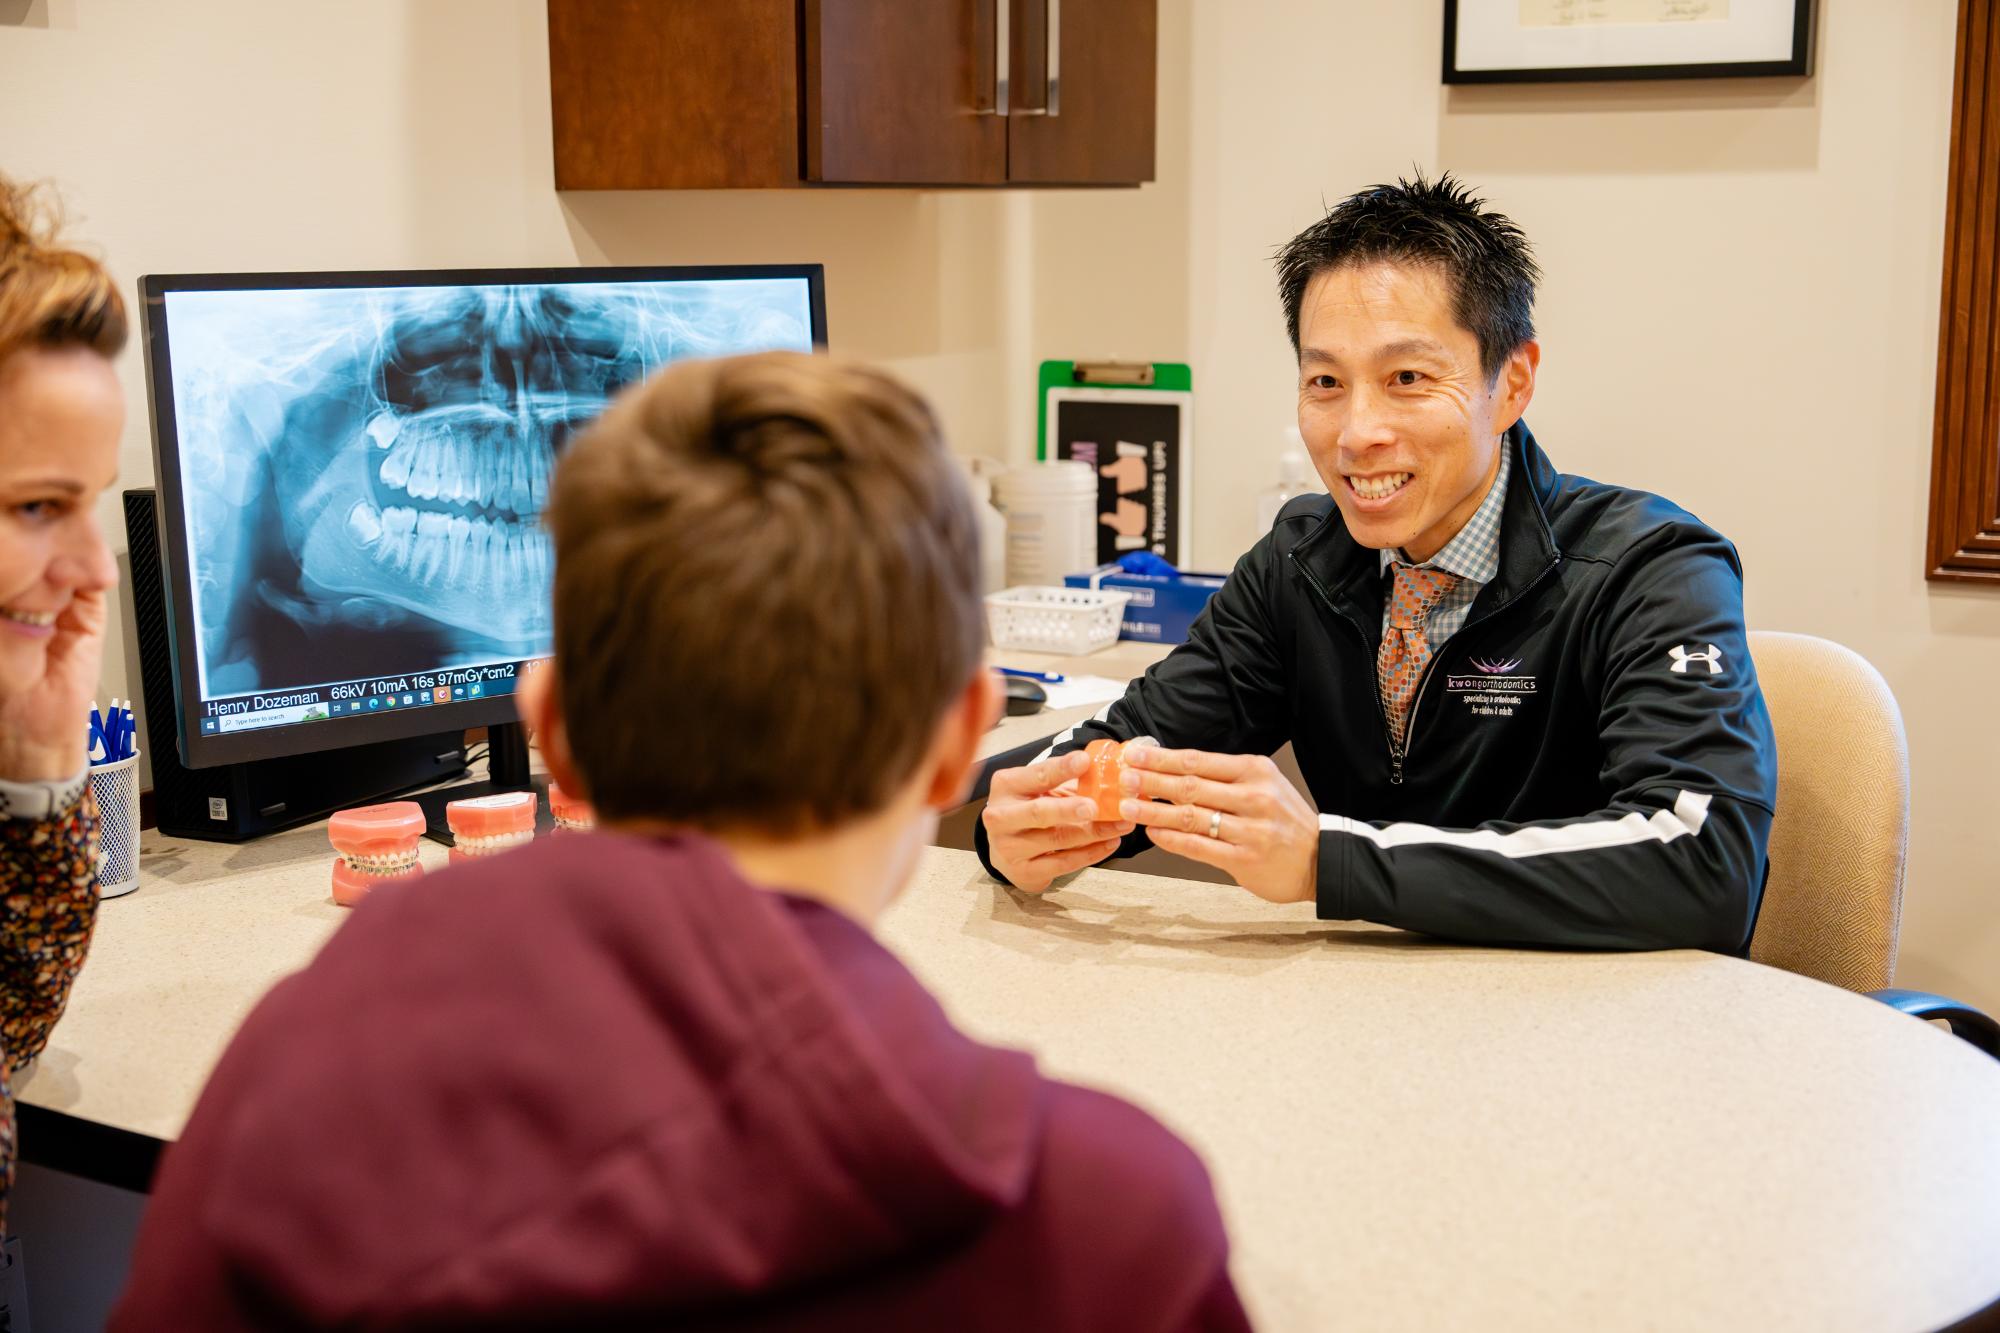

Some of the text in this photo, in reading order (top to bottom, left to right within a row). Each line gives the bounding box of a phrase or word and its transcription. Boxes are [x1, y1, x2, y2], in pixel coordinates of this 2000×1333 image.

[1152, 473, 1166, 541] THUMBS
[207, 700, 249, 717] Henry
[253, 692, 319, 710] Dozeman
[331, 682, 366, 700] 66kV
[370, 678, 409, 695] 10mA
[411, 676, 435, 690] 16s
[1448, 678, 1536, 690] kwongorthodontics
